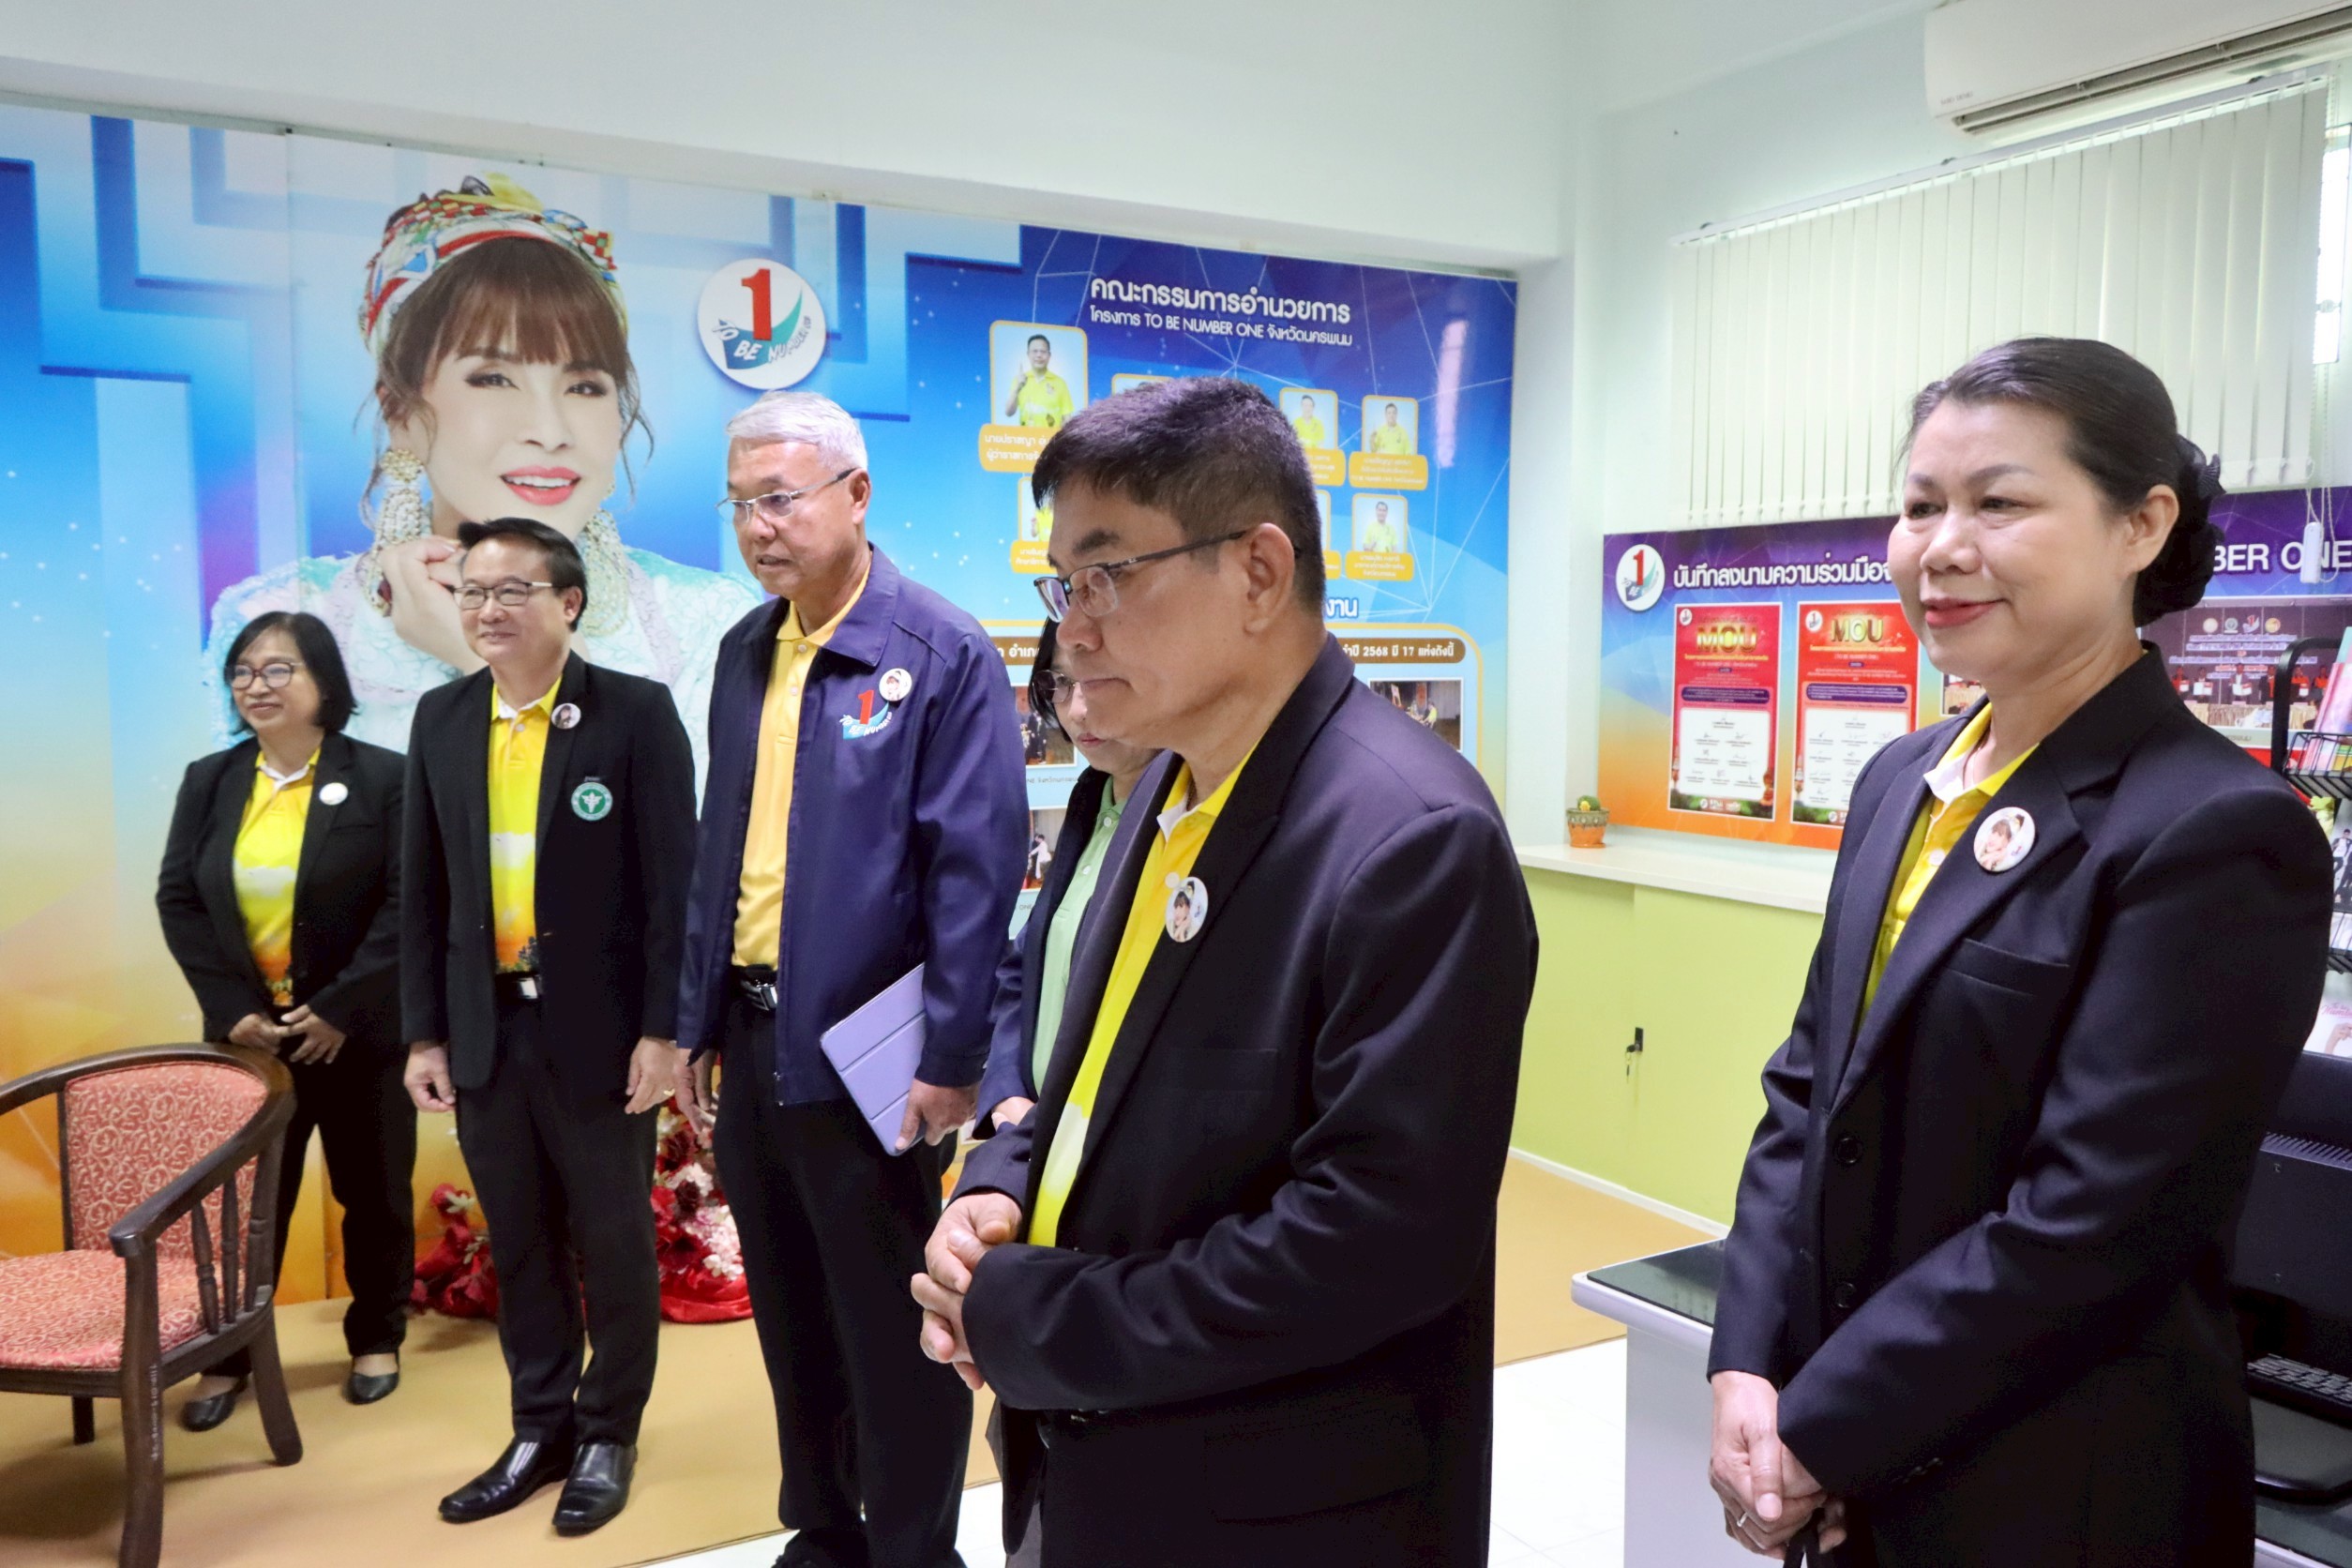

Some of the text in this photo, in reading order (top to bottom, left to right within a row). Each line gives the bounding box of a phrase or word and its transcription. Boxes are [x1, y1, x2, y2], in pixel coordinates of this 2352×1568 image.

[741, 268, 772, 341] 1
[1091, 278, 1350, 324] คณะกรรมการอำนวยการ
[712, 318, 740, 340] TO
[733, 340, 762, 361] BE
[1090, 305, 1353, 346] โครงการ TO BE NUMBER ONE จังหวัดนครพนม
[987, 447, 1040, 462] ผู้ว่าราชการจั
[1633, 550, 1644, 586] 1
[1673, 552, 1892, 588] บันทึกลงนามความร่วมมือจ
[2213, 543, 2269, 572] BER
[1326, 598, 1358, 617] งาน
[1696, 626, 1757, 653] MOU
[1831, 619, 1883, 643] MOU
[1008, 642, 1039, 658] อำเภ
[1343, 641, 1455, 656] จำปี 2568 มี 17 แห่งดังนี้
[857, 689, 875, 725] 1
